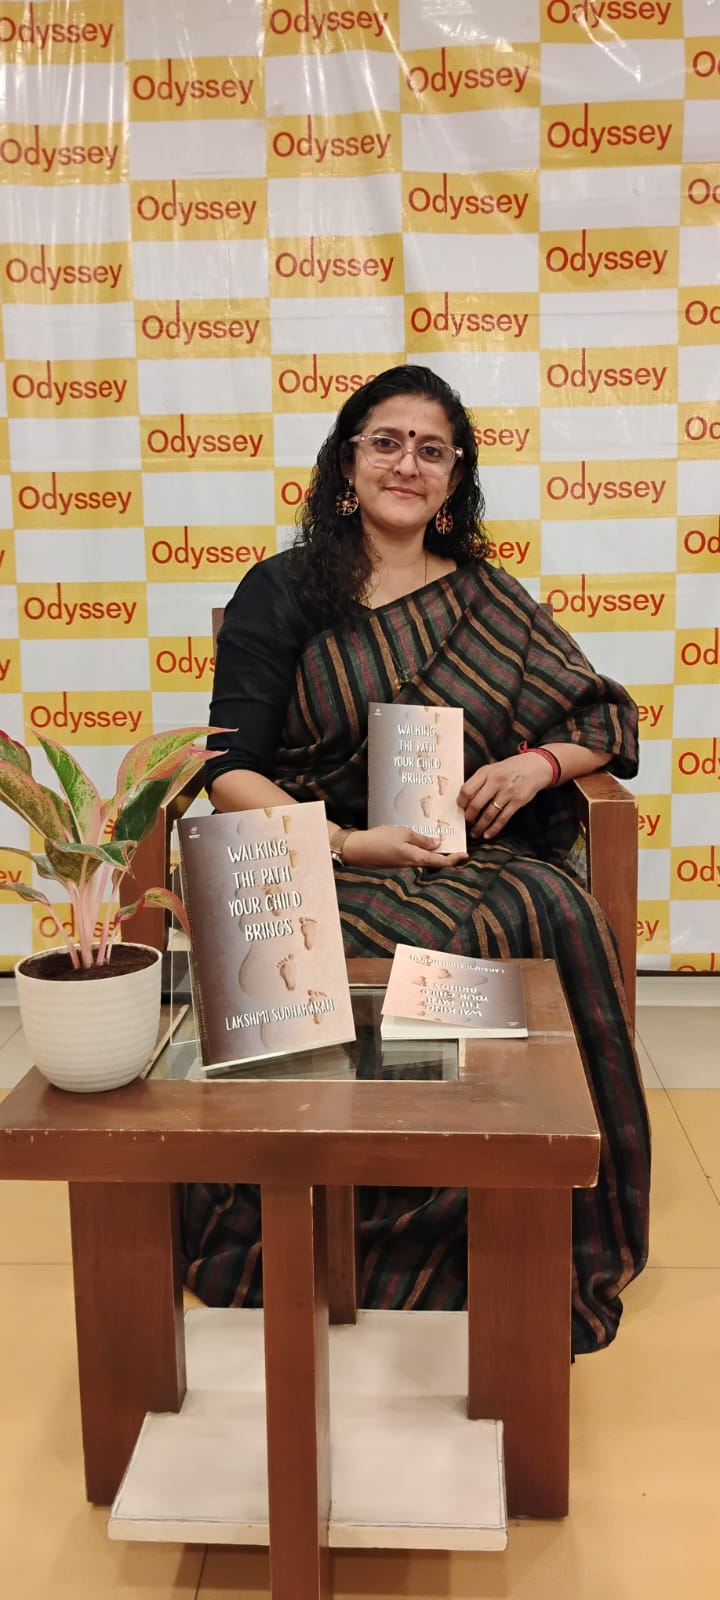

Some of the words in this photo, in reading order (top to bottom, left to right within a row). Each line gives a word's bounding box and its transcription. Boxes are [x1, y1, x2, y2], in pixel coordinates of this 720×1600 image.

[0, 2, 114, 49] Odyssey
[270, 0, 388, 42] Odyssey
[133, 59, 254, 105] Odyssey
[407, 47, 529, 96] Odyssey
[0, 125, 118, 172] Odyssey
[272, 115, 391, 160] Odyssey
[547, 103, 673, 154] Odyssey
[137, 180, 257, 226] Odyssey
[408, 173, 529, 219] Odyssey
[6, 245, 122, 290] Odyssey
[275, 236, 394, 282] Odyssey
[546, 229, 668, 278] Odyssey
[142, 300, 259, 346] Odyssey
[411, 291, 528, 338] Odyssey
[13, 360, 127, 406] Odyssey
[278, 353, 377, 399] Odyss
[547, 348, 668, 393] Odyssey
[147, 414, 263, 458] Odyssey
[18, 471, 132, 516] Odyssey
[547, 460, 665, 505] Odyssey
[152, 526, 266, 571] Odyssey
[24, 582, 137, 625] Odyssey
[546, 573, 665, 618] Odyssey
[31, 691, 142, 734] Odyssey
[397, 724, 438, 736] WALKING
[393, 755, 415, 769] YOUR
[401, 772, 434, 785] BRINGS
[227, 838, 288, 863] WALKING
[232, 869, 259, 890] THE
[261, 865, 292, 885] PATH
[228, 896, 263, 917] YOUR
[265, 891, 302, 912] CHILD
[244, 918, 294, 942] BRINGS
[225, 1009, 271, 1031] LAKSHMI
[271, 998, 336, 1022] SUDHAKARAN
